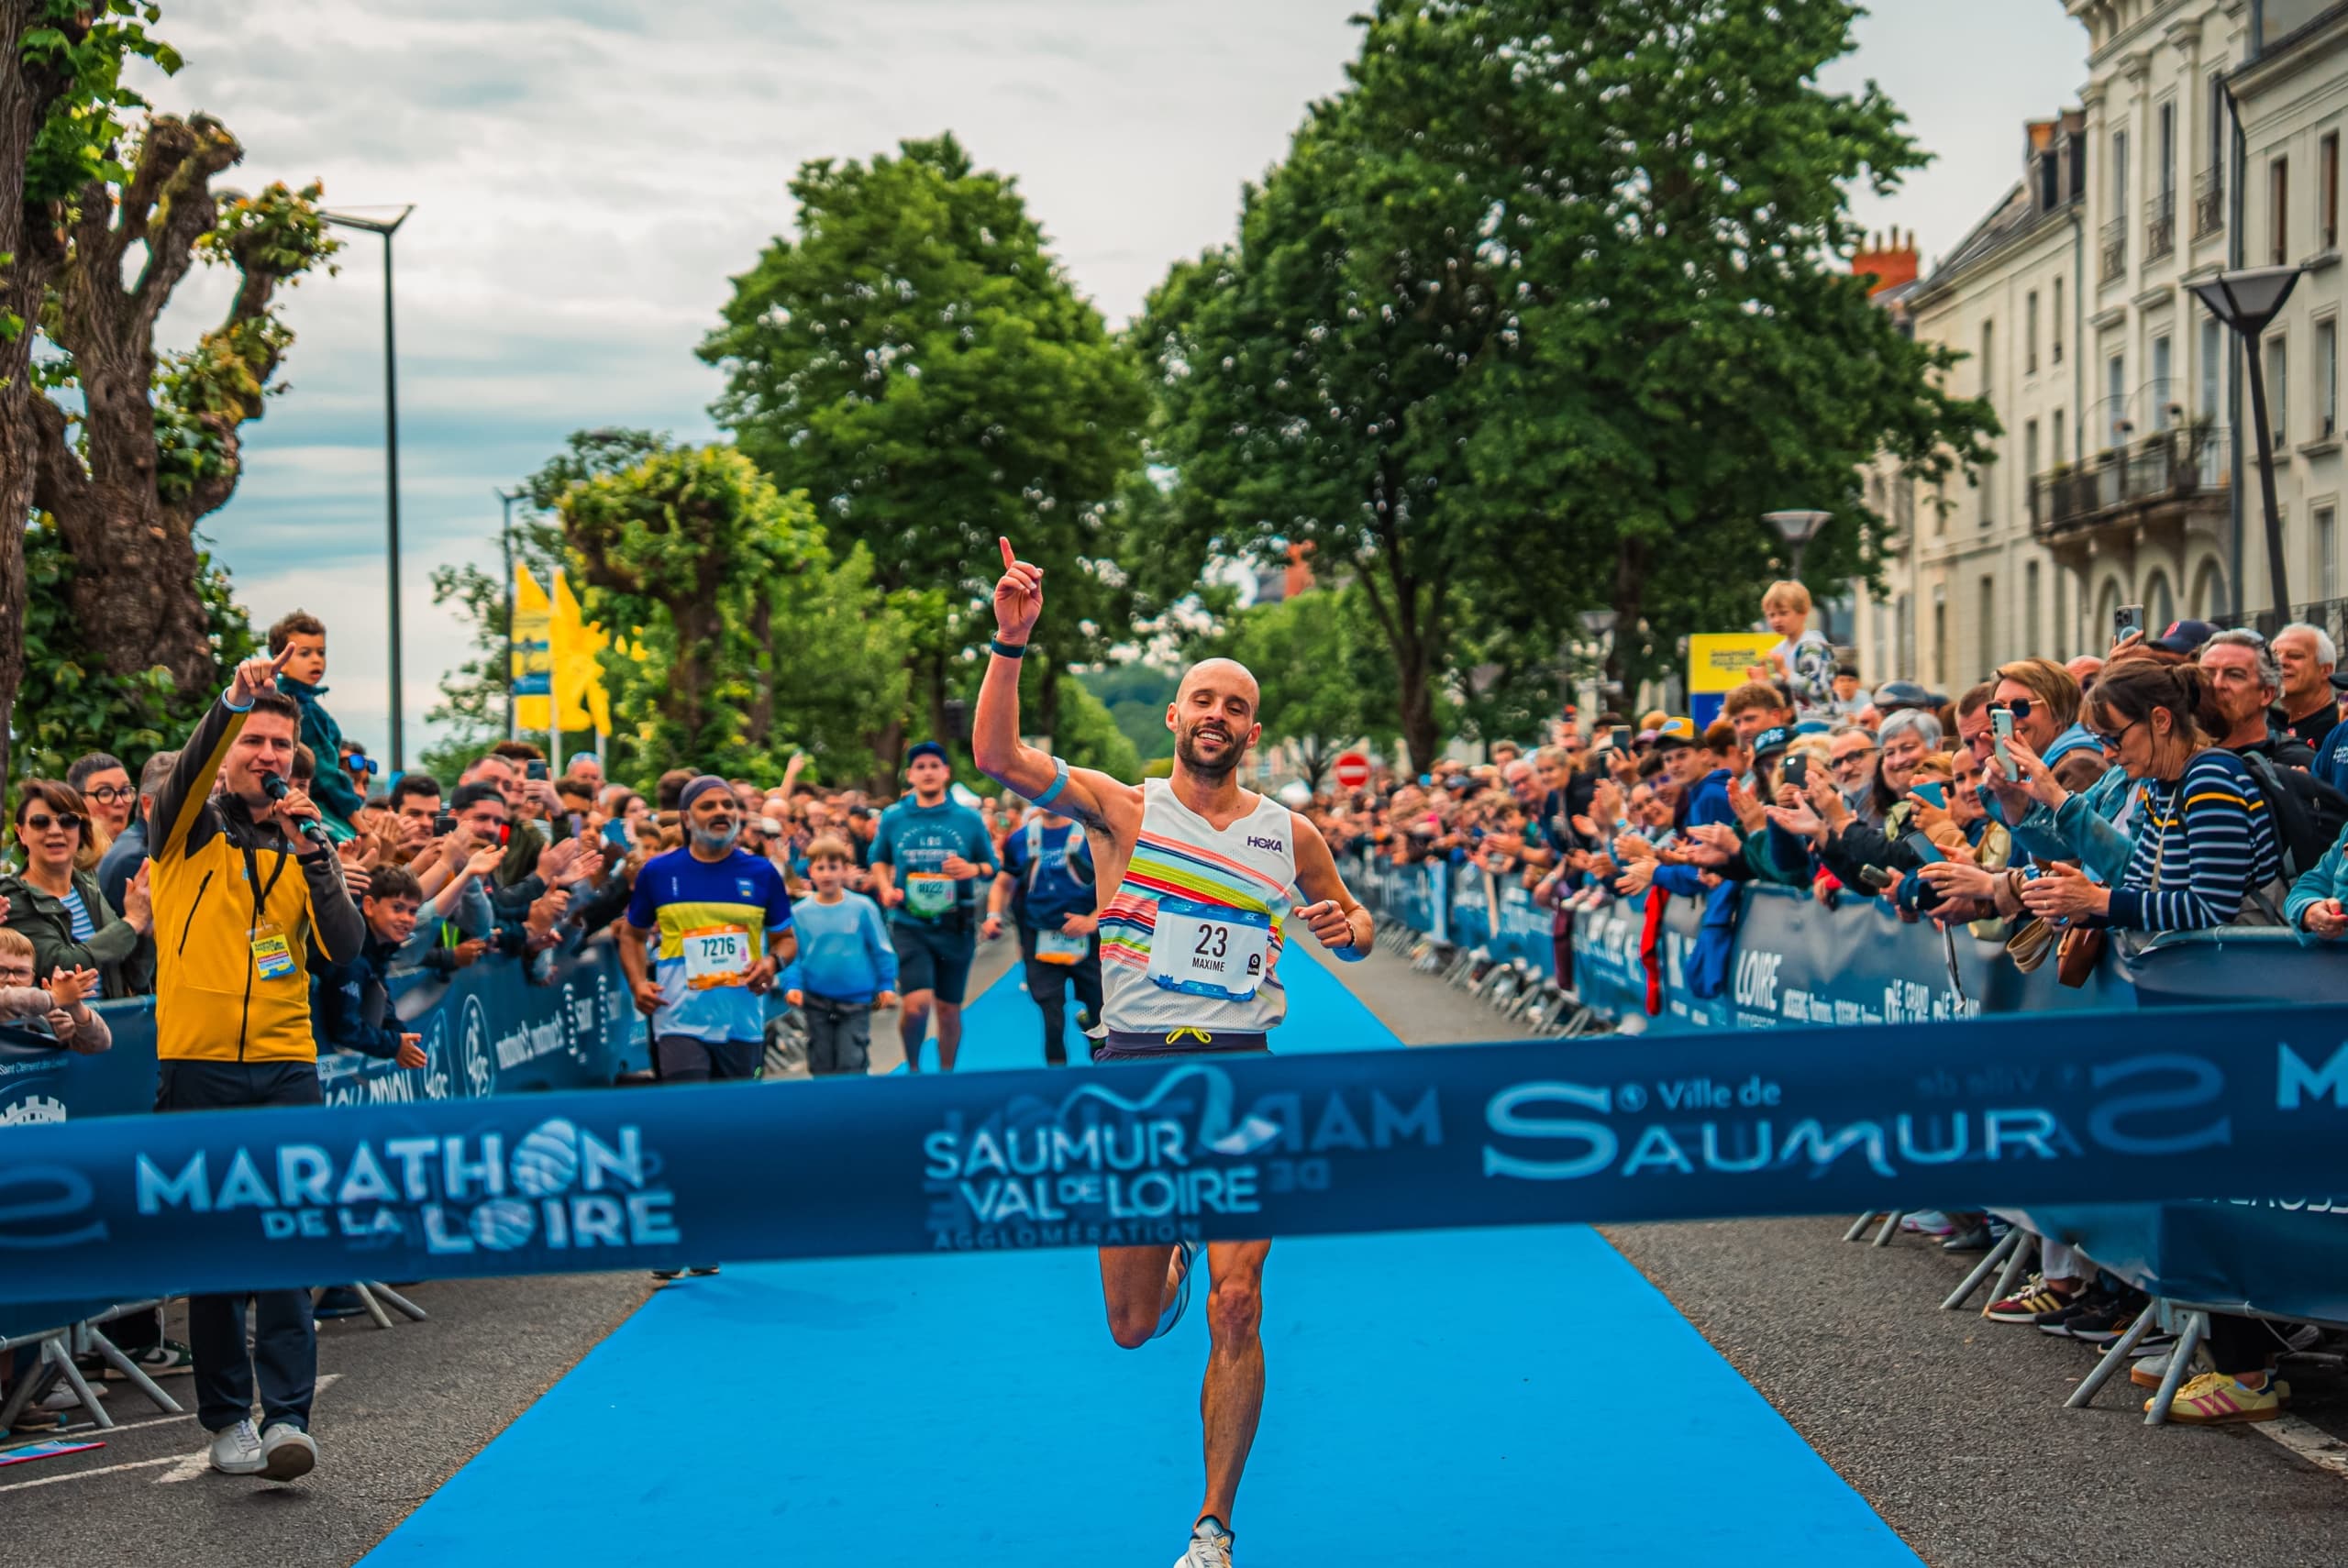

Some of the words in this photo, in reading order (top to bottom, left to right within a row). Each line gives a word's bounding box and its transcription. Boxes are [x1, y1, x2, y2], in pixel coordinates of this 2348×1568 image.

[1247, 835, 1282, 853] HOKA
[701, 936, 736, 957] 7276
[1194, 923, 1228, 958] 23
[1191, 956, 1225, 973] MAXIME
[1734, 949, 1782, 1011] LOIRE
[1657, 1080, 1732, 1111] Ville
[1747, 1075, 1781, 1109] de
[924, 1118, 1188, 1181] SAUMUR
[1482, 1080, 2059, 1183] SAUMUR
[136, 1118, 641, 1216] MARATHON
[958, 1175, 1065, 1223] VAL
[1059, 1178, 1102, 1205] DE
[1107, 1166, 1262, 1219] LOIRE
[260, 1209, 330, 1240] DE
[339, 1208, 404, 1236] LA
[421, 1191, 682, 1255] LOIRE
[934, 1220, 1202, 1251] AGGLOMÉRATION
